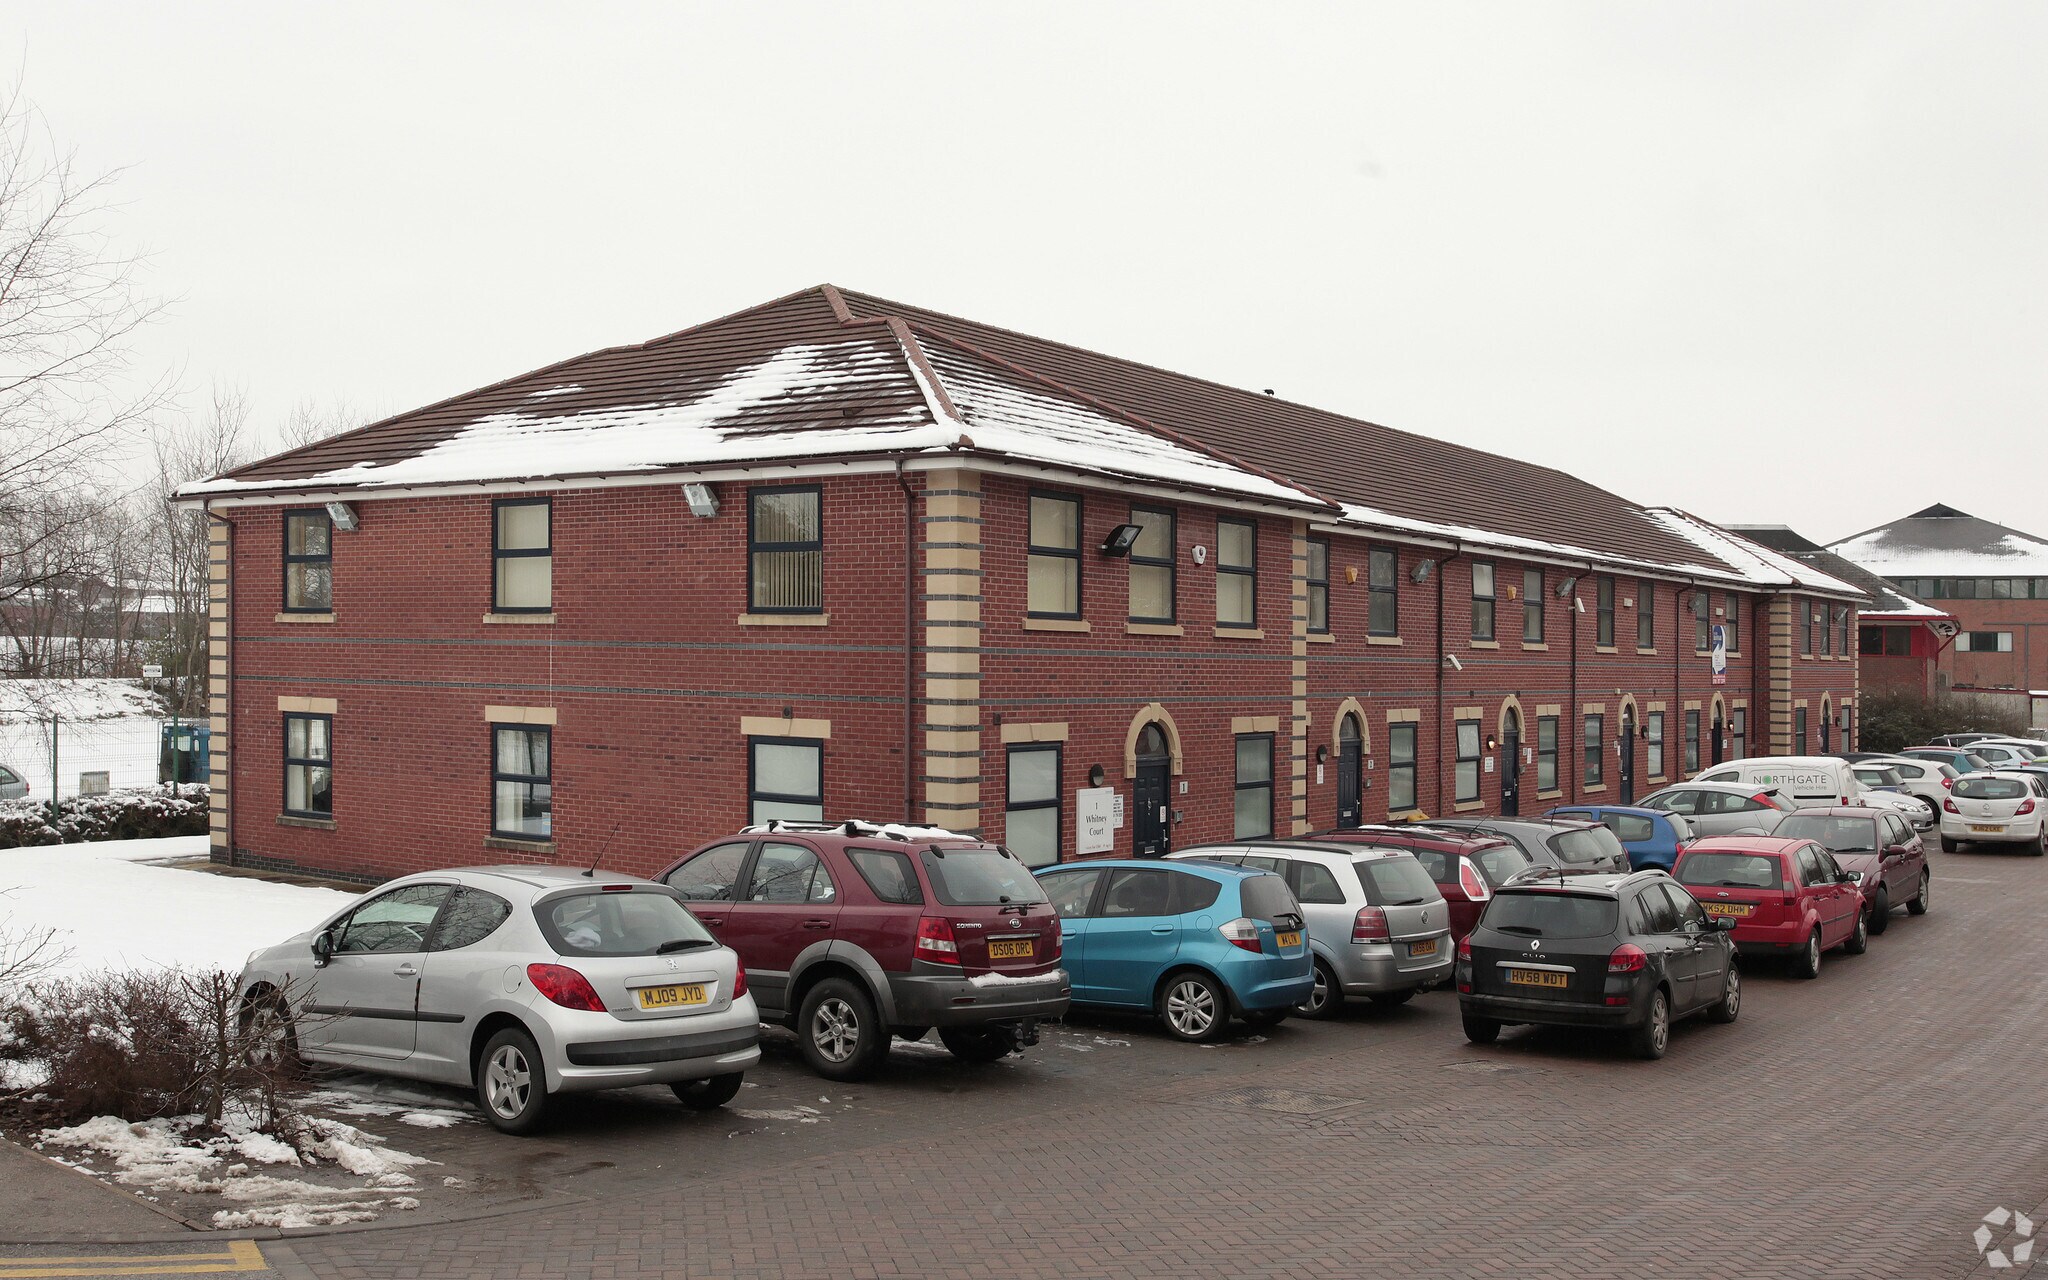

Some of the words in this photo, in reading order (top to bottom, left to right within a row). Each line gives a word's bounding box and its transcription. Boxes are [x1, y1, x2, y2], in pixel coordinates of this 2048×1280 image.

[1753, 775, 1827, 785] NORTHGATE
[1086, 814, 1107, 824] Whitney
[1089, 827, 1104, 836] Court
[992, 943, 1014, 956] DS06
[1016, 942, 1030, 954] ORC
[1512, 970, 1540, 983] HV58
[1543, 973, 1565, 985] WDT
[644, 988, 678, 1005] MJ09
[681, 987, 701, 1001] JYD
